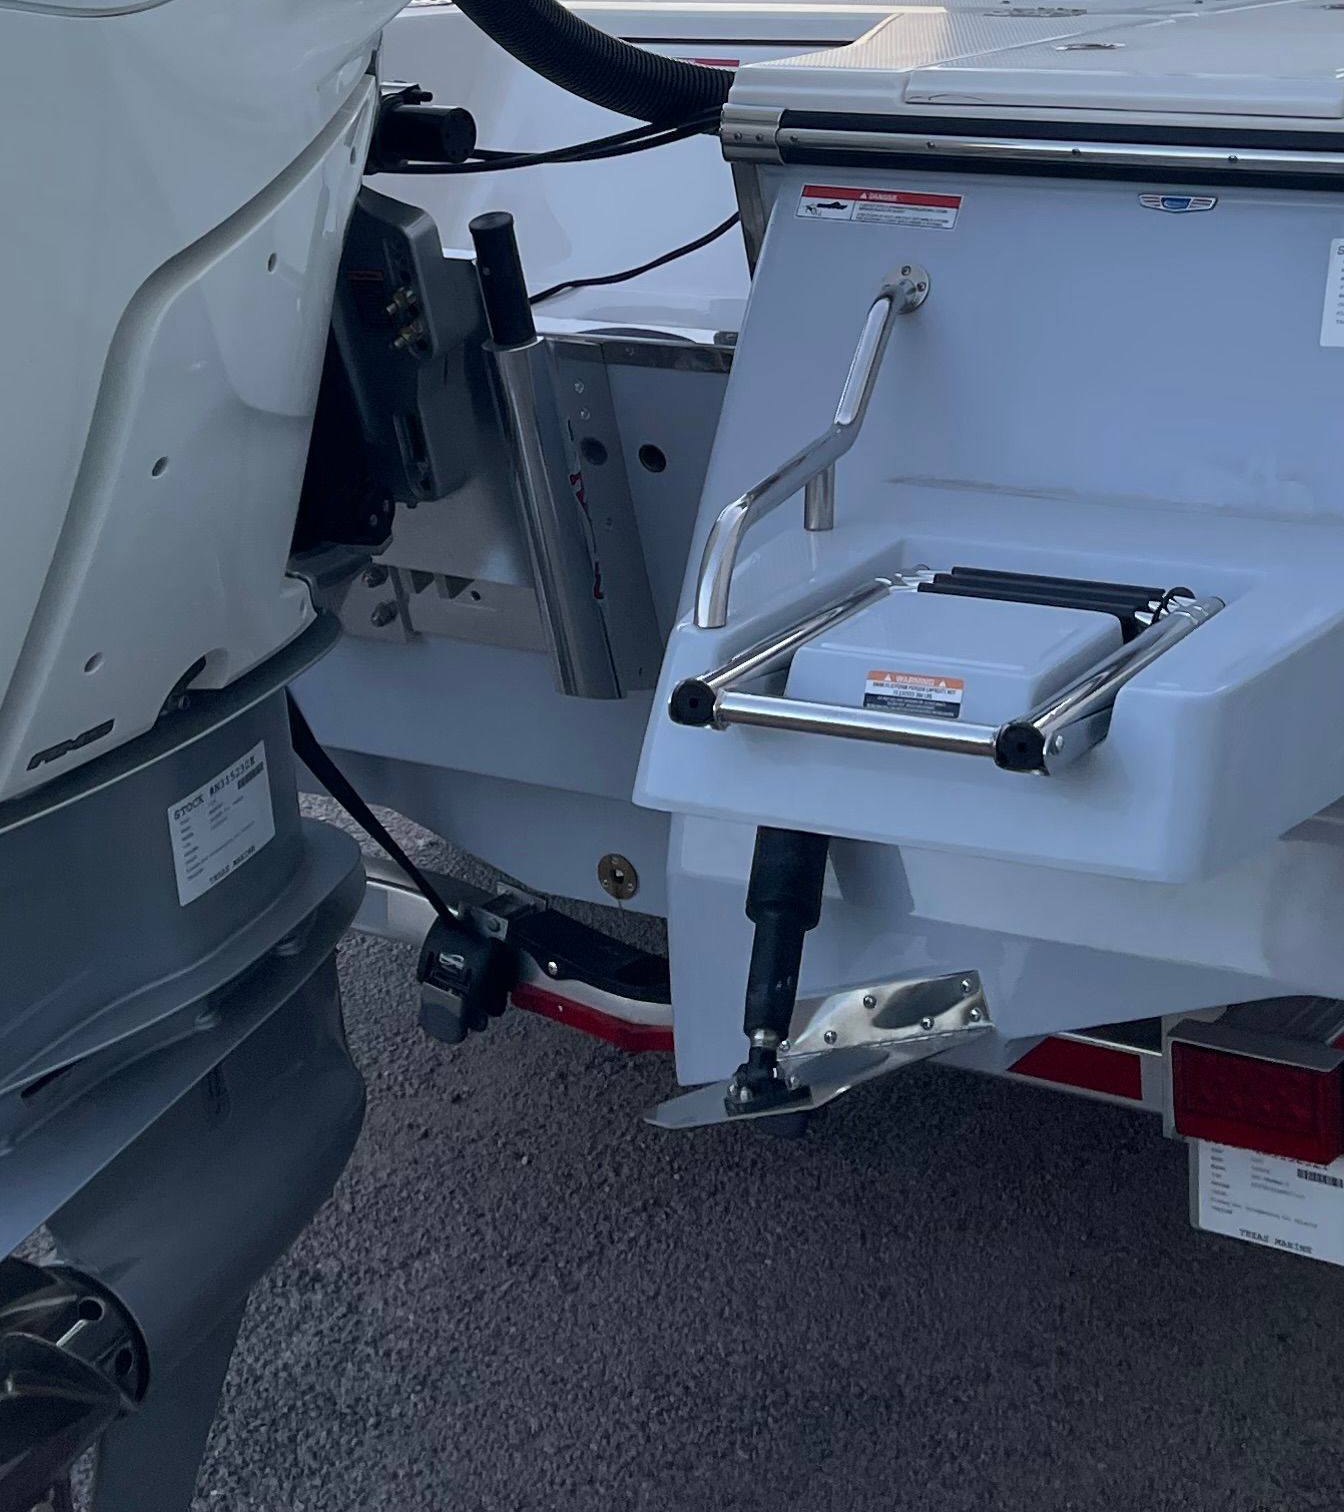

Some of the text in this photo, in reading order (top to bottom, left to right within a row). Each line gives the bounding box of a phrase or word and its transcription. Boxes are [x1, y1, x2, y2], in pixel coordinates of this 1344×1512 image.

[896, 675, 935, 686] WARNING
[173, 793, 205, 820] STOCK
[1239, 1228, 1312, 1254] TEXAS MARINE
